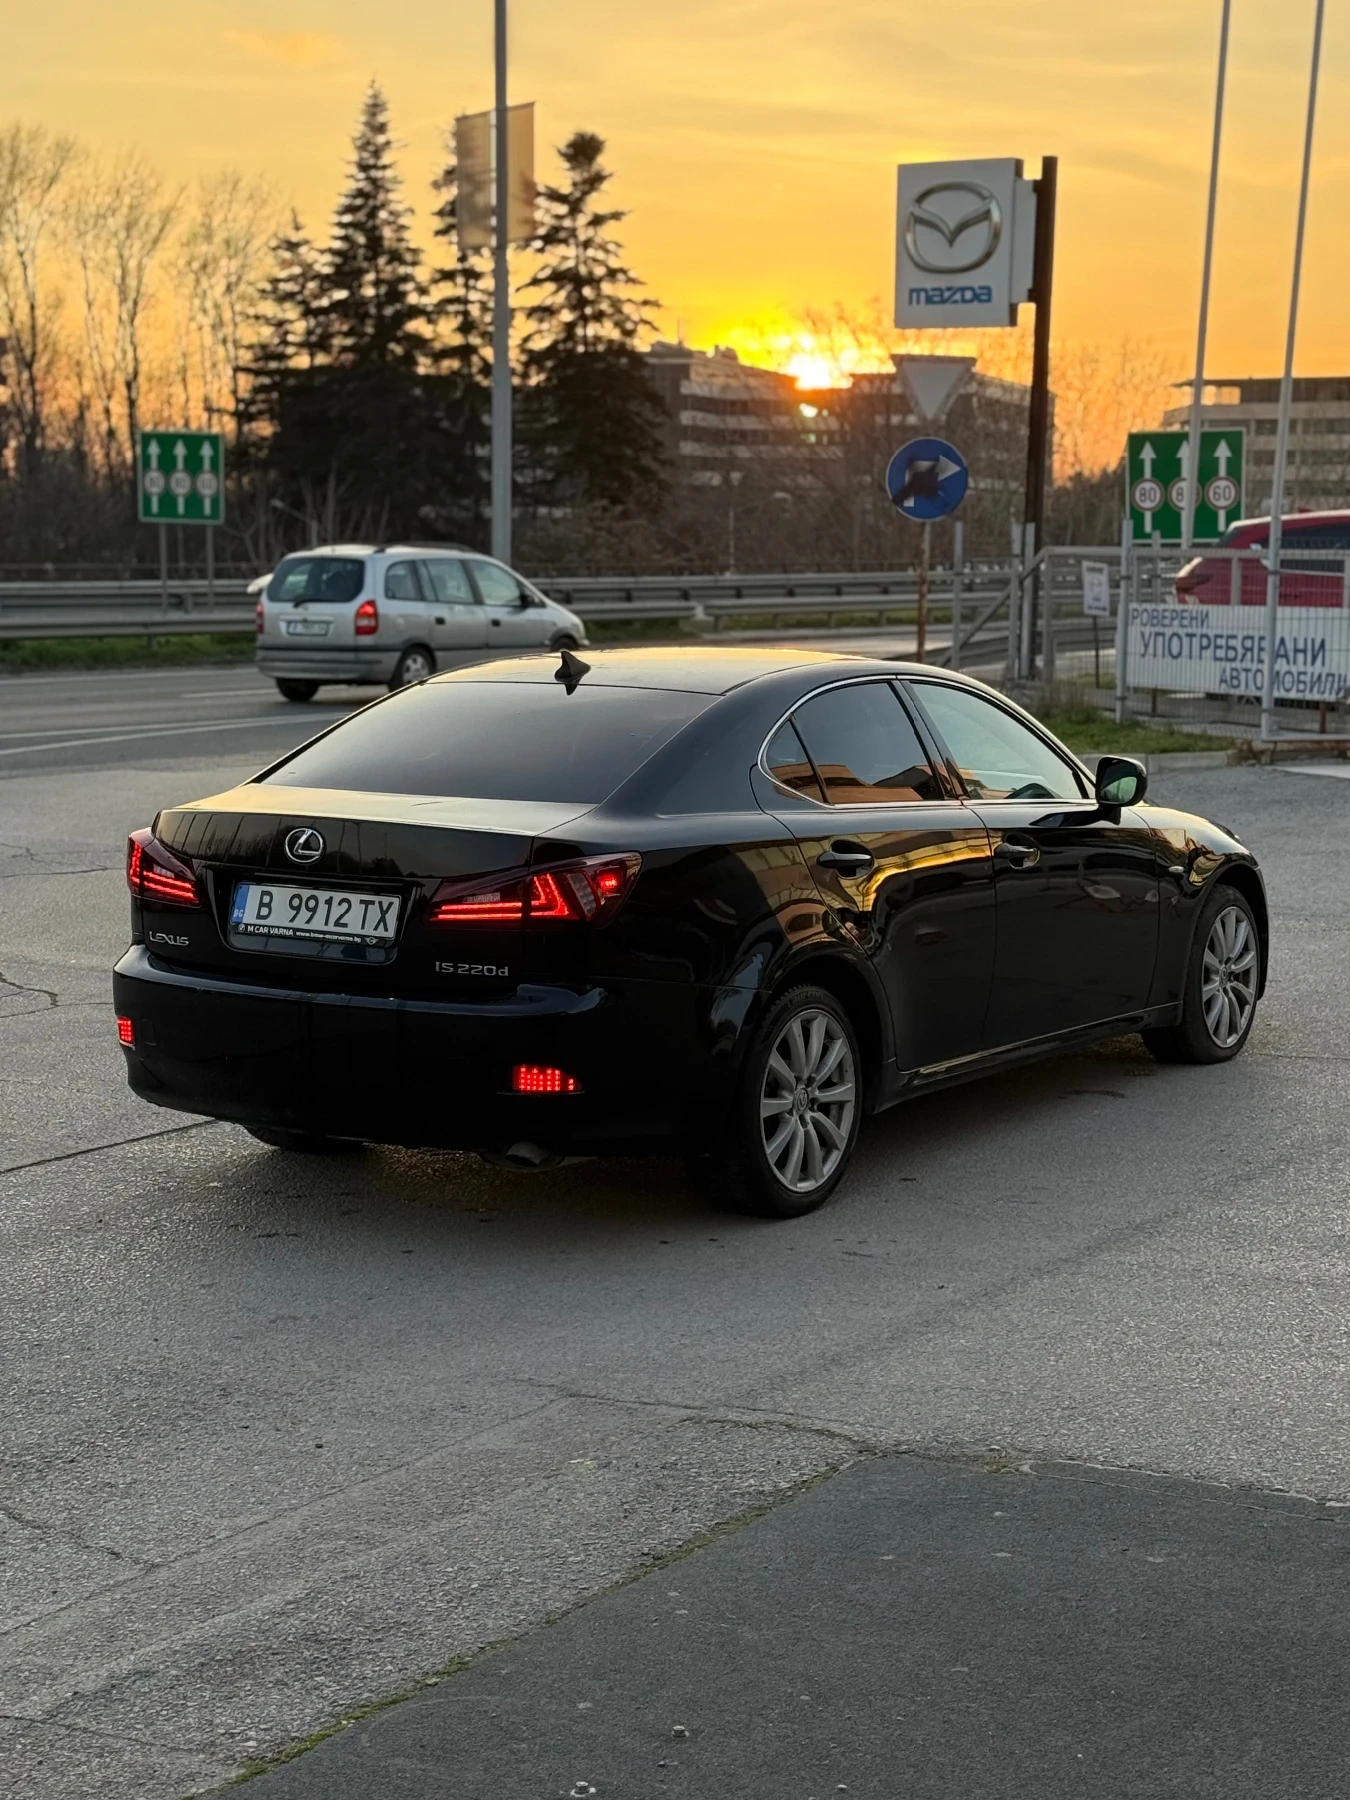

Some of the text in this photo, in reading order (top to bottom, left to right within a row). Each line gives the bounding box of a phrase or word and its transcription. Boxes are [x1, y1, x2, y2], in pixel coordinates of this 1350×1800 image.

[1139, 486, 1157, 503] 80
[1175, 486, 1185, 503] 8
[1213, 485, 1232, 502] 60
[1130, 608, 1210, 628] РОВЕРЕНИ
[255, 890, 394, 932] B 9912 TX
[149, 931, 189, 946] LEXUS
[247, 925, 255, 933] M
[255, 926, 269, 934] CAR
[269, 927, 294, 936] VARNA
[435, 961, 509, 976] IS 220d
